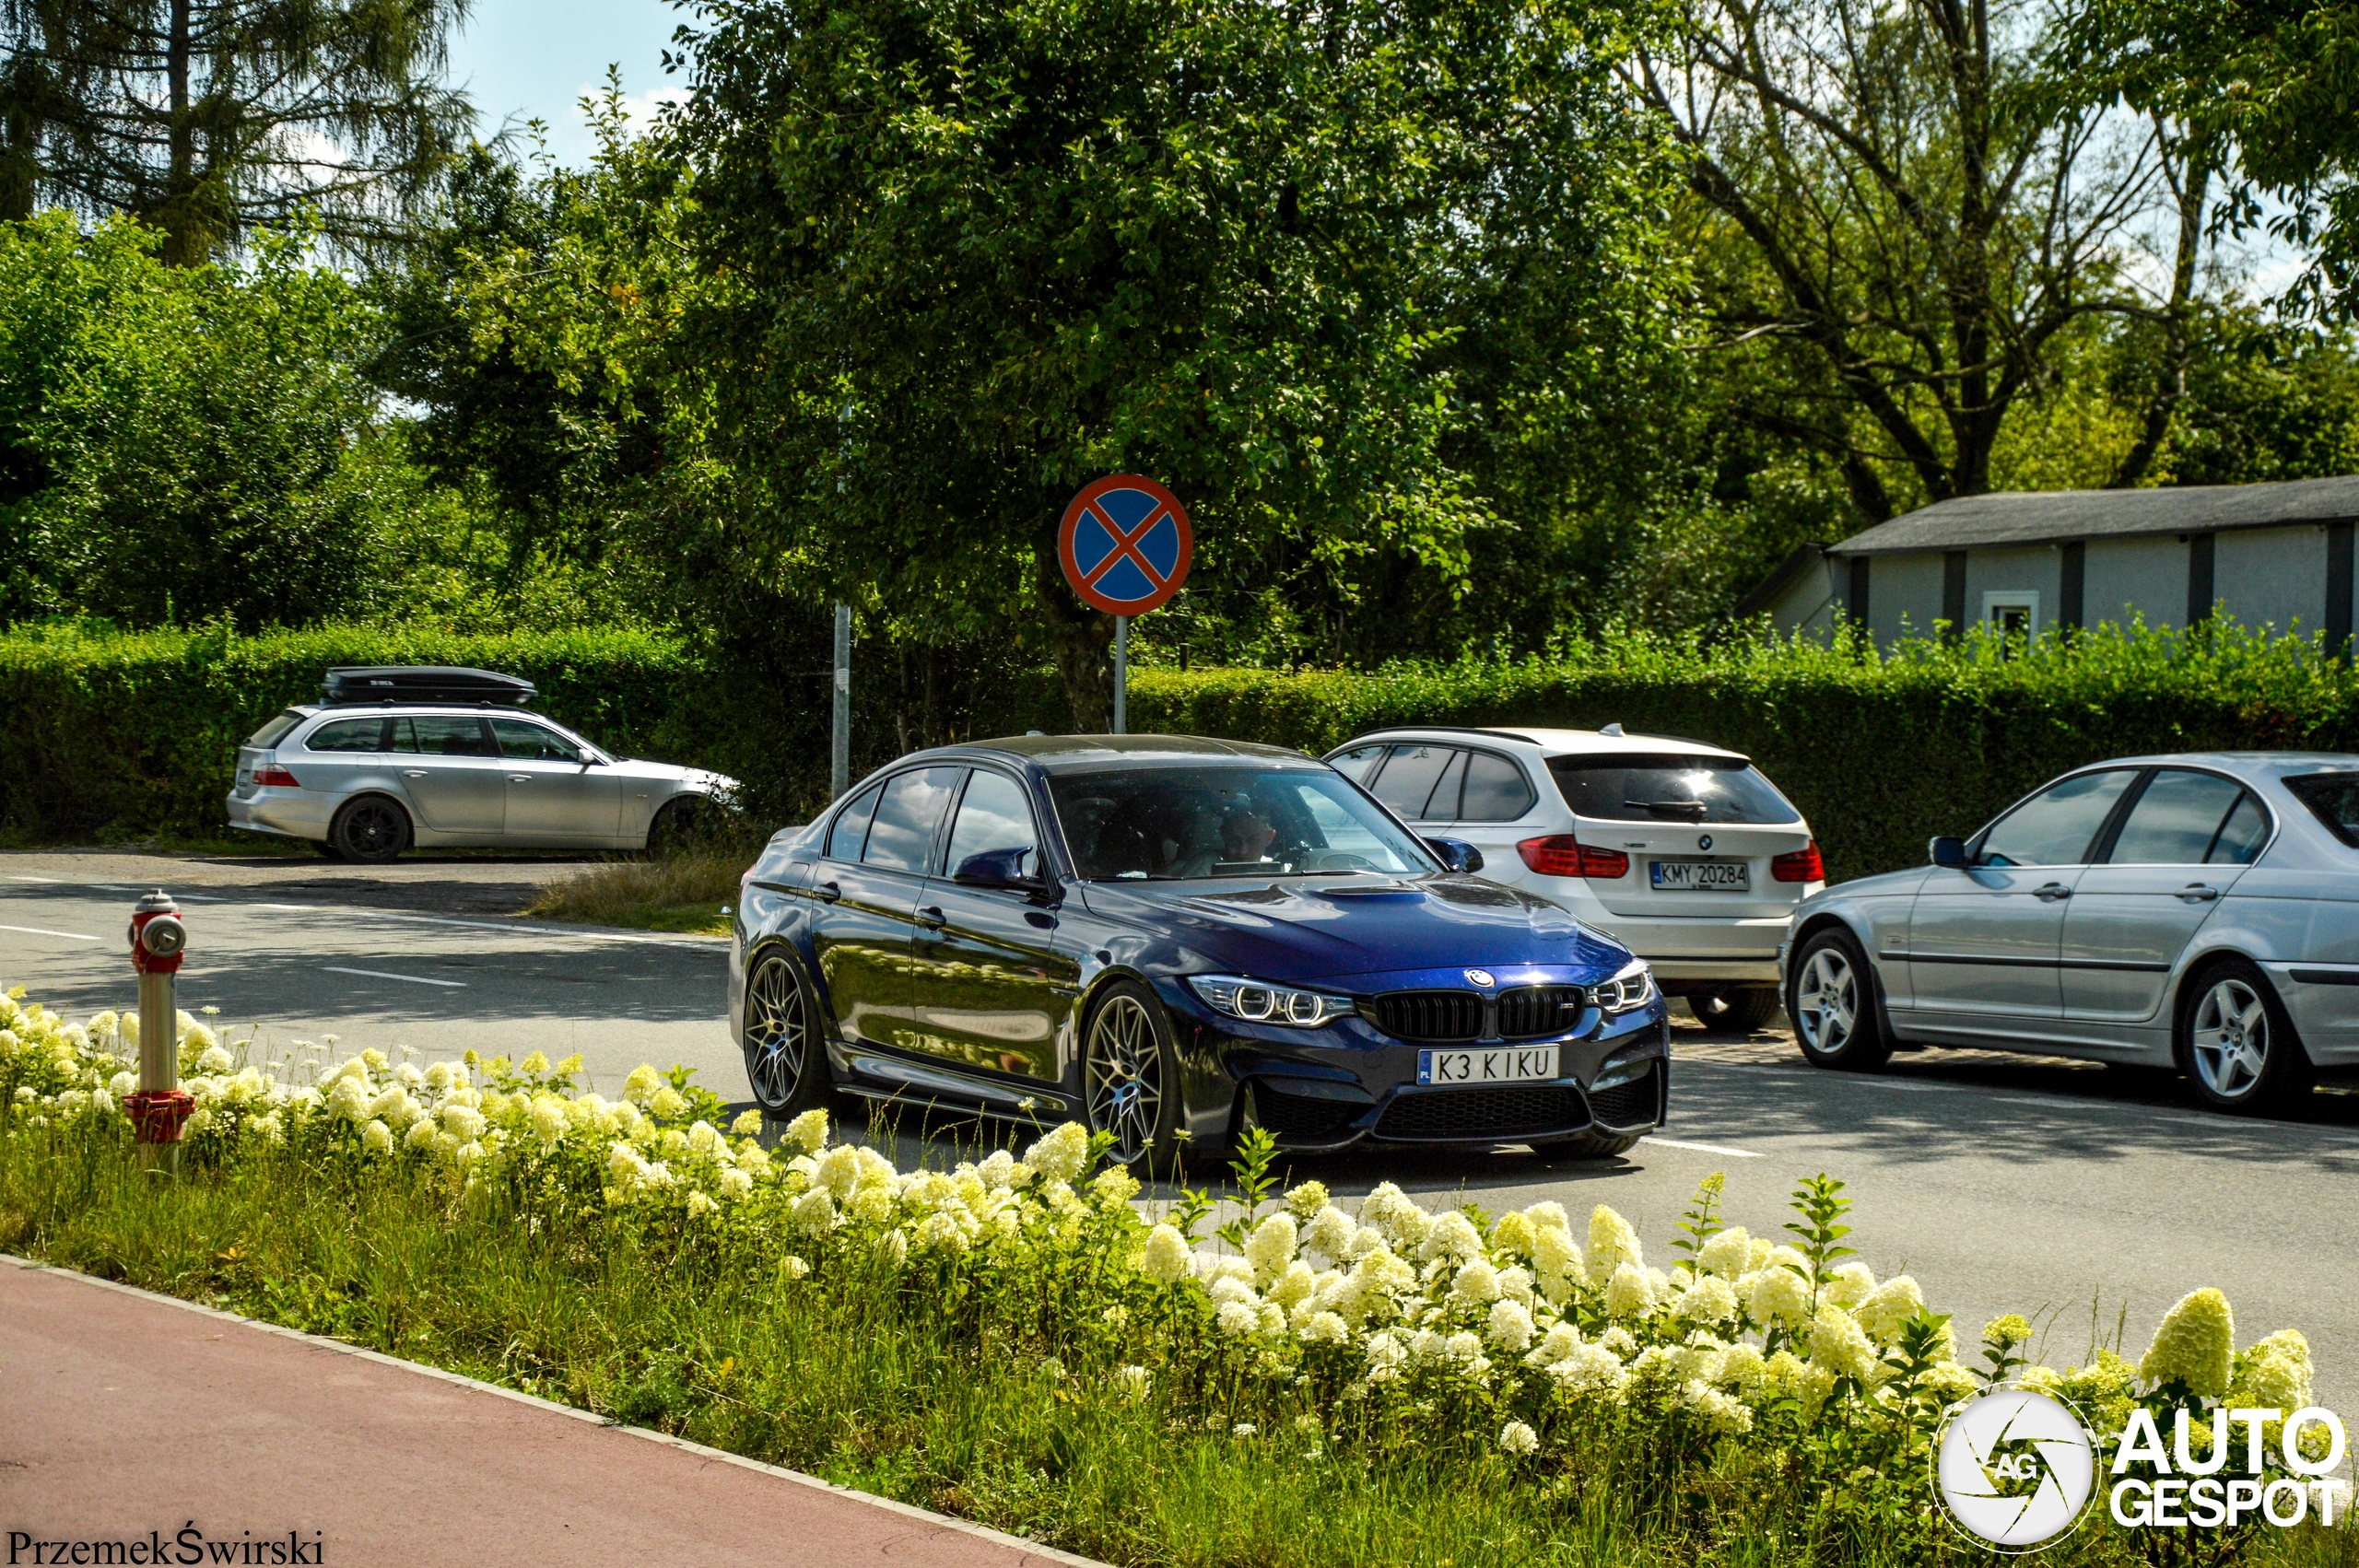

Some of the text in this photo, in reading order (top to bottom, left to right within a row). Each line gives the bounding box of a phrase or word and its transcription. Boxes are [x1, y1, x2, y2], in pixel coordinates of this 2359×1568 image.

[1661, 865, 1746, 883] KMY 20284
[1438, 1050, 1549, 1081] K3 KIKU
[1420, 1071, 1430, 1079] PL
